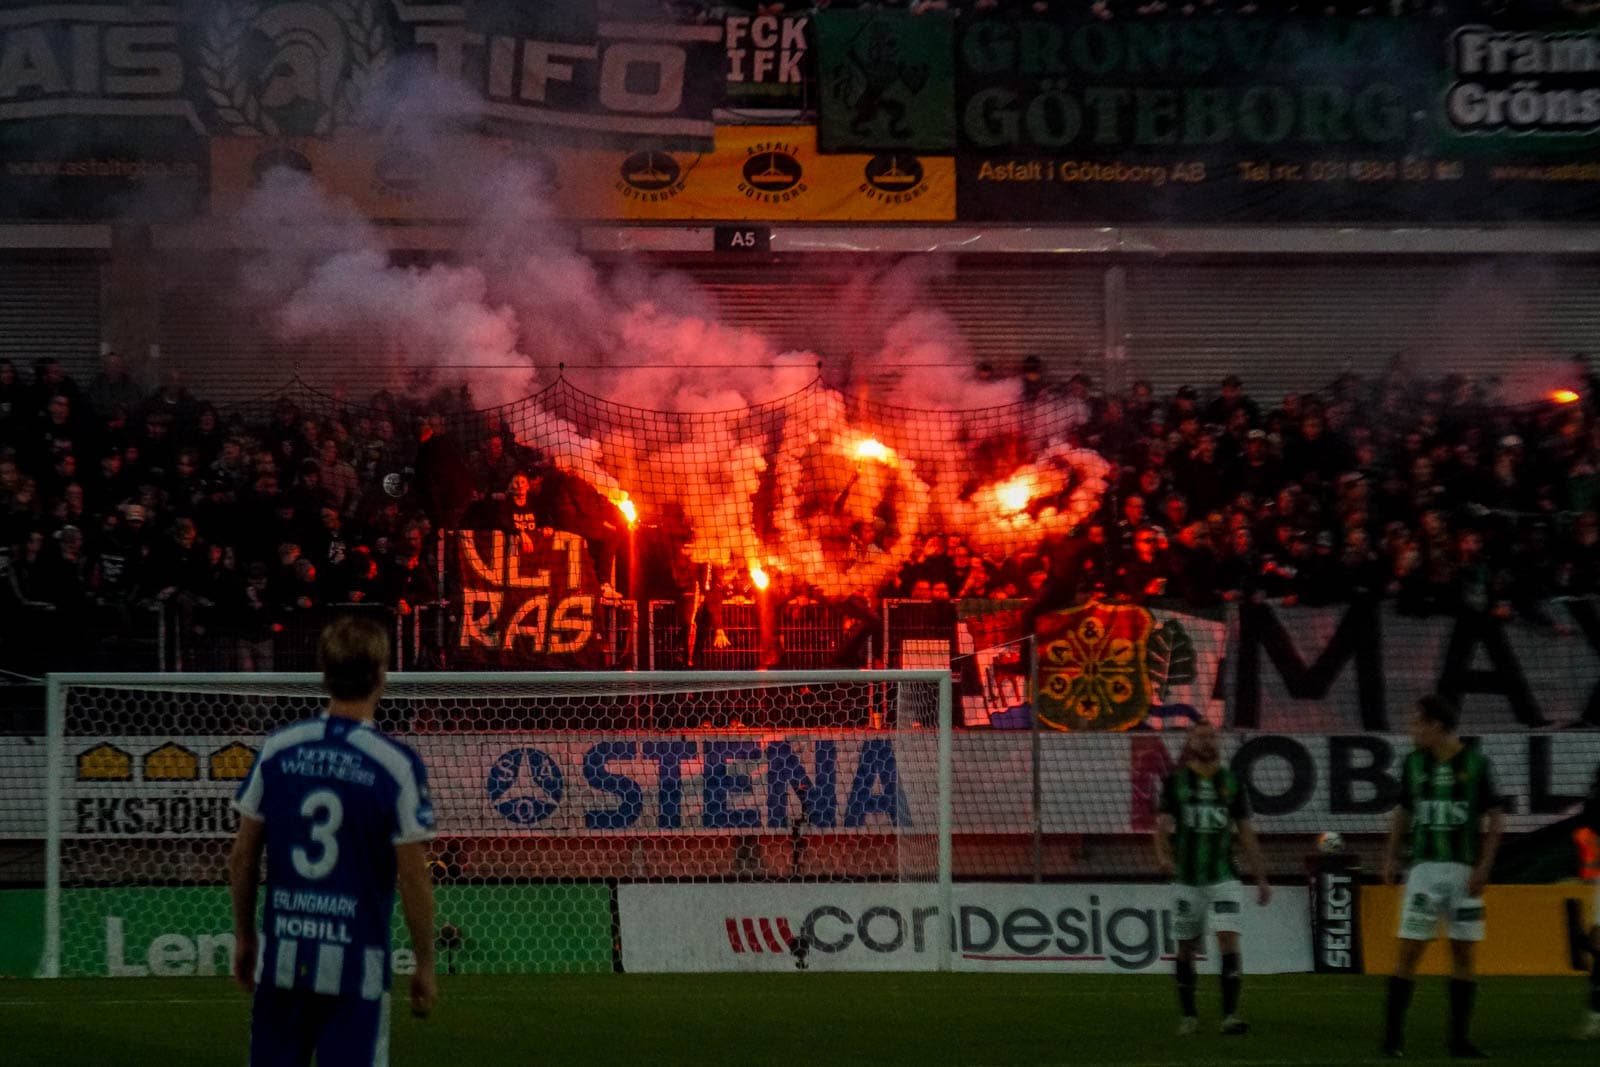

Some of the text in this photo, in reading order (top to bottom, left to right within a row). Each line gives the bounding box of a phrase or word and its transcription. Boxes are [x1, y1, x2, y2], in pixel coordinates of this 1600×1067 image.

[725, 15, 809, 49] FCK
[414, 25, 688, 113] TIFO
[725, 49, 804, 83] IFK
[962, 80, 1404, 146] GÖTEBORG
[978, 161, 1040, 182] Asfalt
[1060, 160, 1168, 187] Göteborg
[1170, 161, 1206, 182] AB
[731, 231, 756, 247] A5
[459, 588, 595, 654] RAS
[584, 740, 912, 829] STENA
[290, 786, 345, 881] 3
[1322, 873, 1353, 968] SELECT
